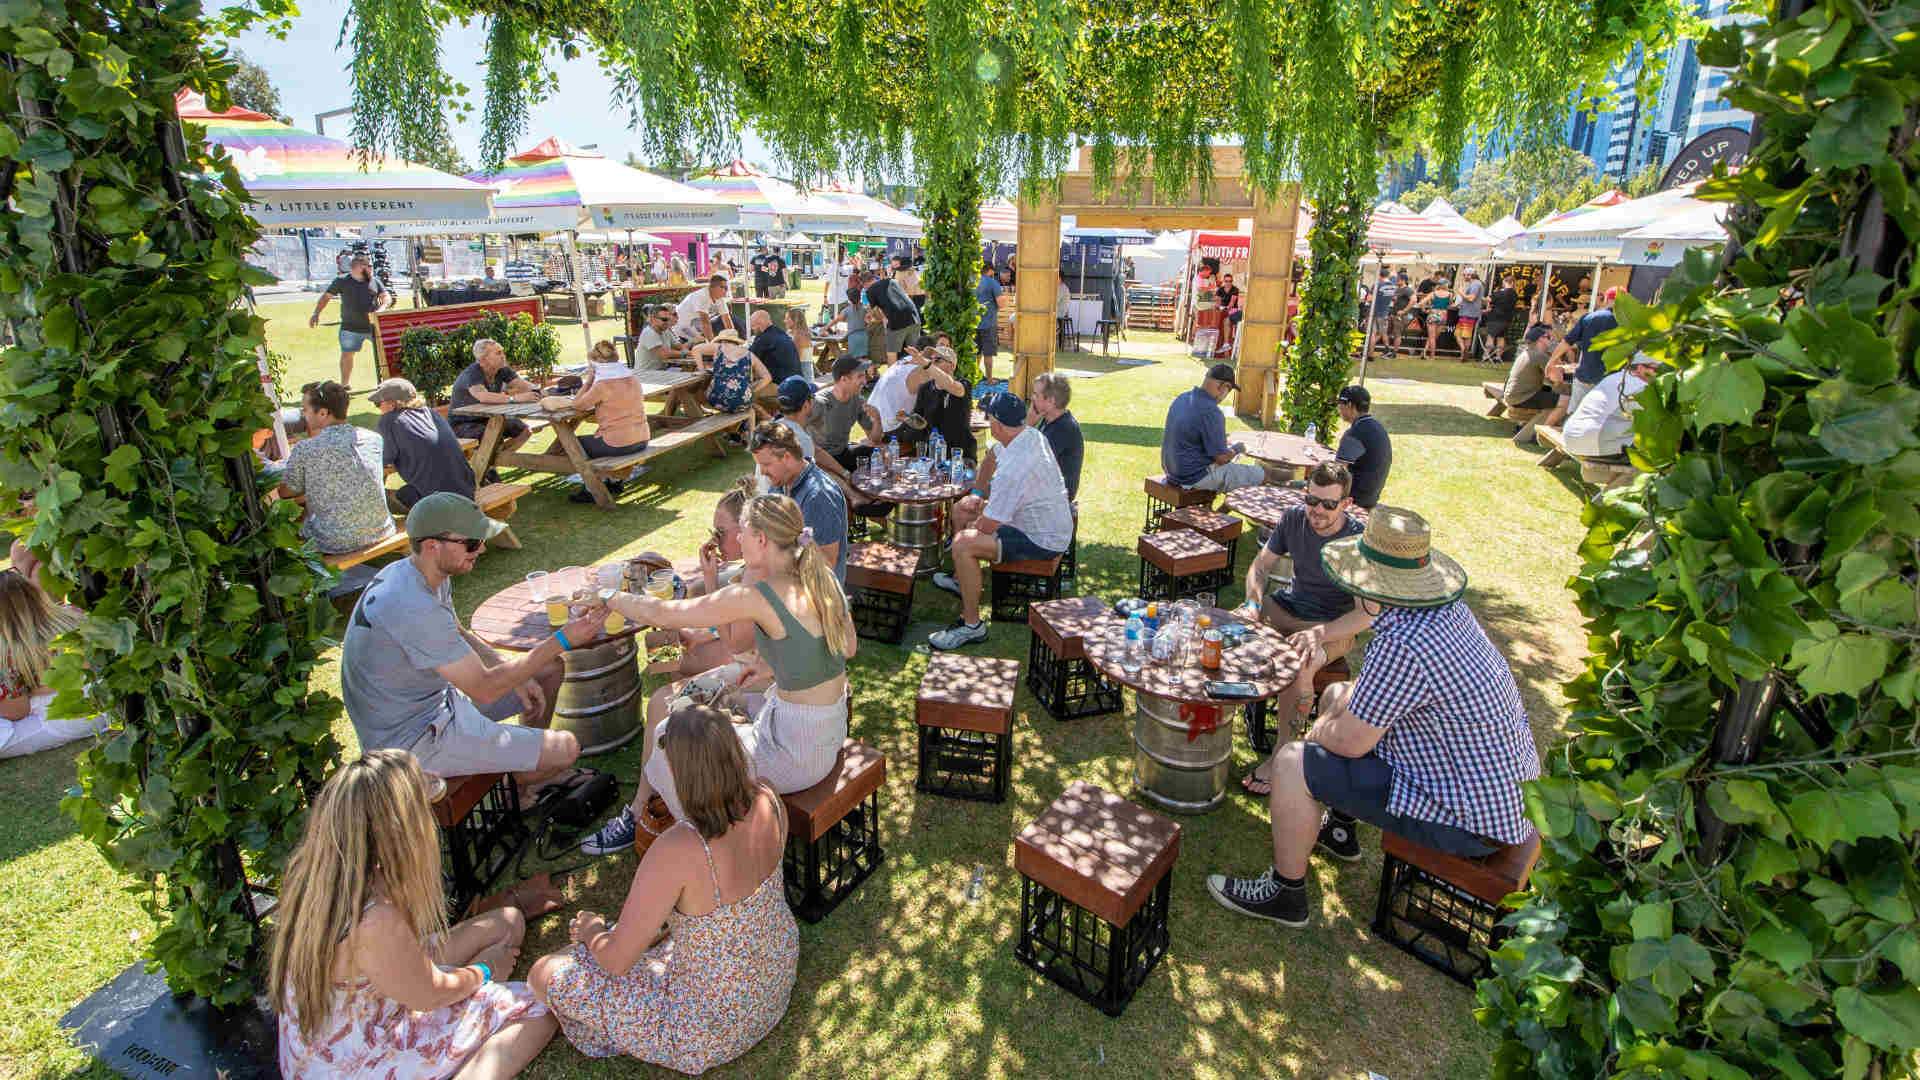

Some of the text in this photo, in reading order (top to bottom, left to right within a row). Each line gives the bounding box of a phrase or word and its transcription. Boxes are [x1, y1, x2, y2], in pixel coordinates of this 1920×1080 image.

[1702, 141, 1729, 158] UP
[264, 203, 273, 212] A
[280, 202, 330, 212] LITTLE
[336, 200, 416, 211] DIFFERENT
[1202, 246, 1233, 258] SOUTH
